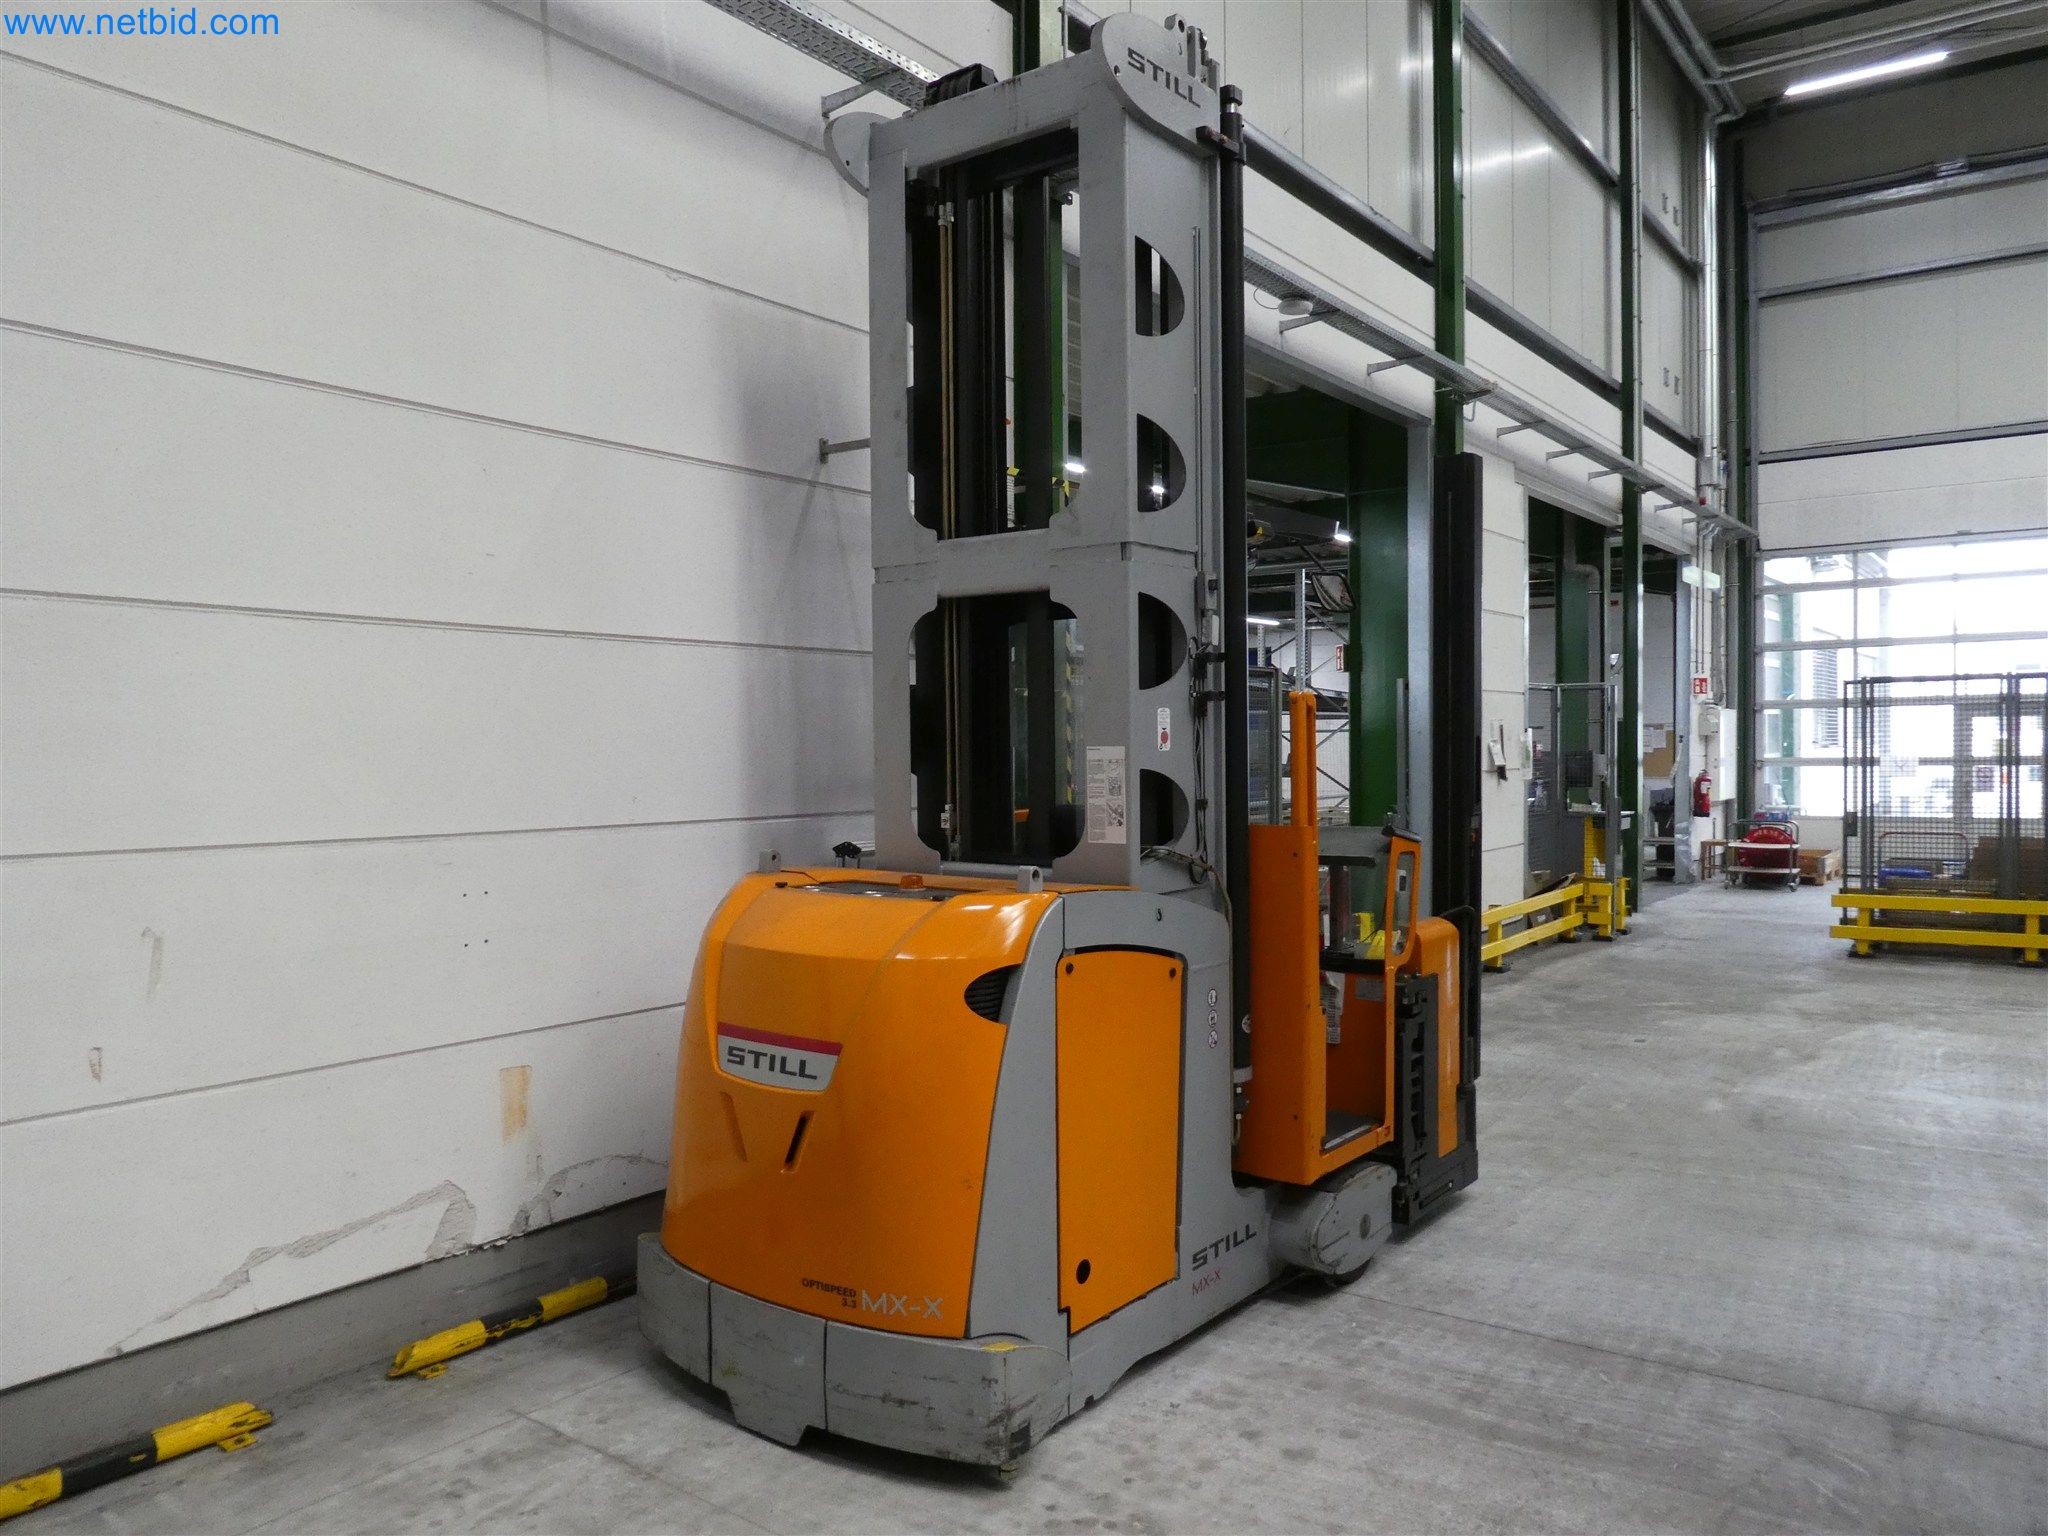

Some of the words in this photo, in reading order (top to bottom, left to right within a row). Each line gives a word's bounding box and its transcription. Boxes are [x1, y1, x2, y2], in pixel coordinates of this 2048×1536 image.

[1128, 47, 1201, 109] STILL
[727, 1045, 818, 1080] STILL
[1192, 1223, 1257, 1271] STILL
[801, 1278, 857, 1298] OPTISPEED
[1192, 1270, 1221, 1296] MX-X
[861, 1289, 943, 1321] MX-X
